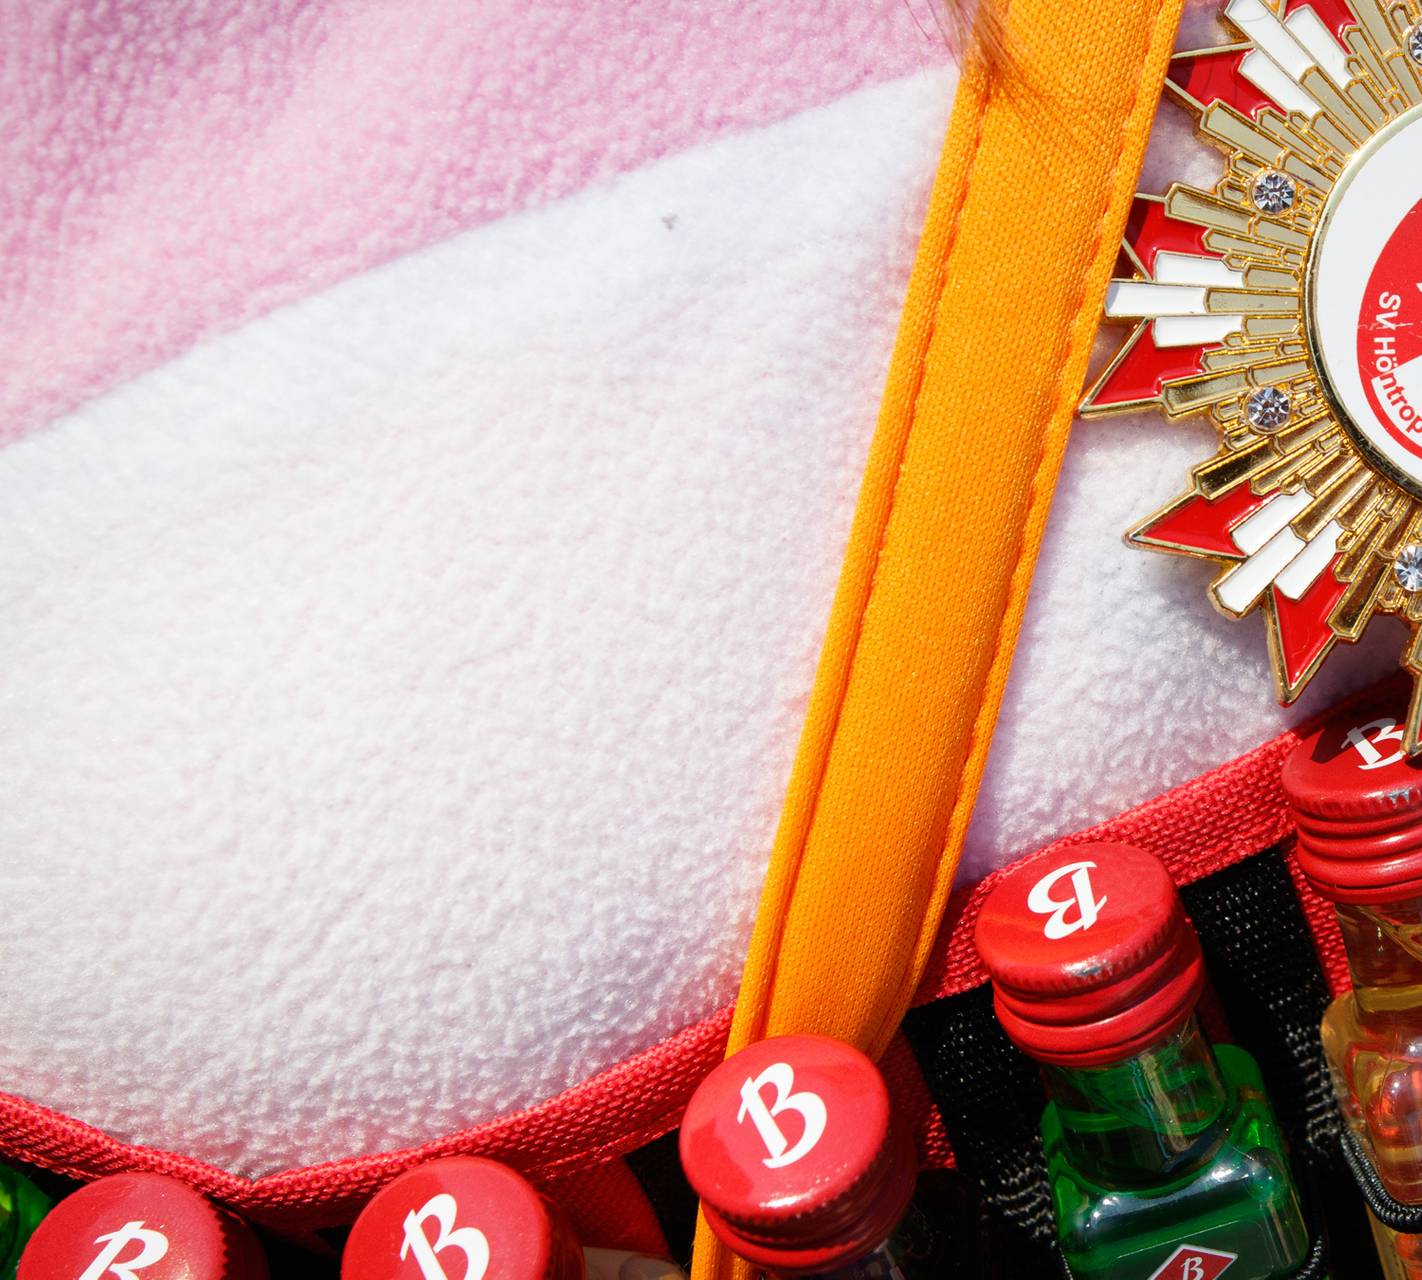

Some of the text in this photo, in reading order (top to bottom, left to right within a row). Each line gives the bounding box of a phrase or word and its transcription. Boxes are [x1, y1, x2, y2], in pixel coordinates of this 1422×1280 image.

[1375, 291, 1401, 330] SV
[1340, 718, 1406, 770] B
[1027, 861, 1108, 940] B
[737, 1062, 827, 1170] B
[400, 1194, 490, 1280] B
[1181, 1256, 1205, 1280] B
